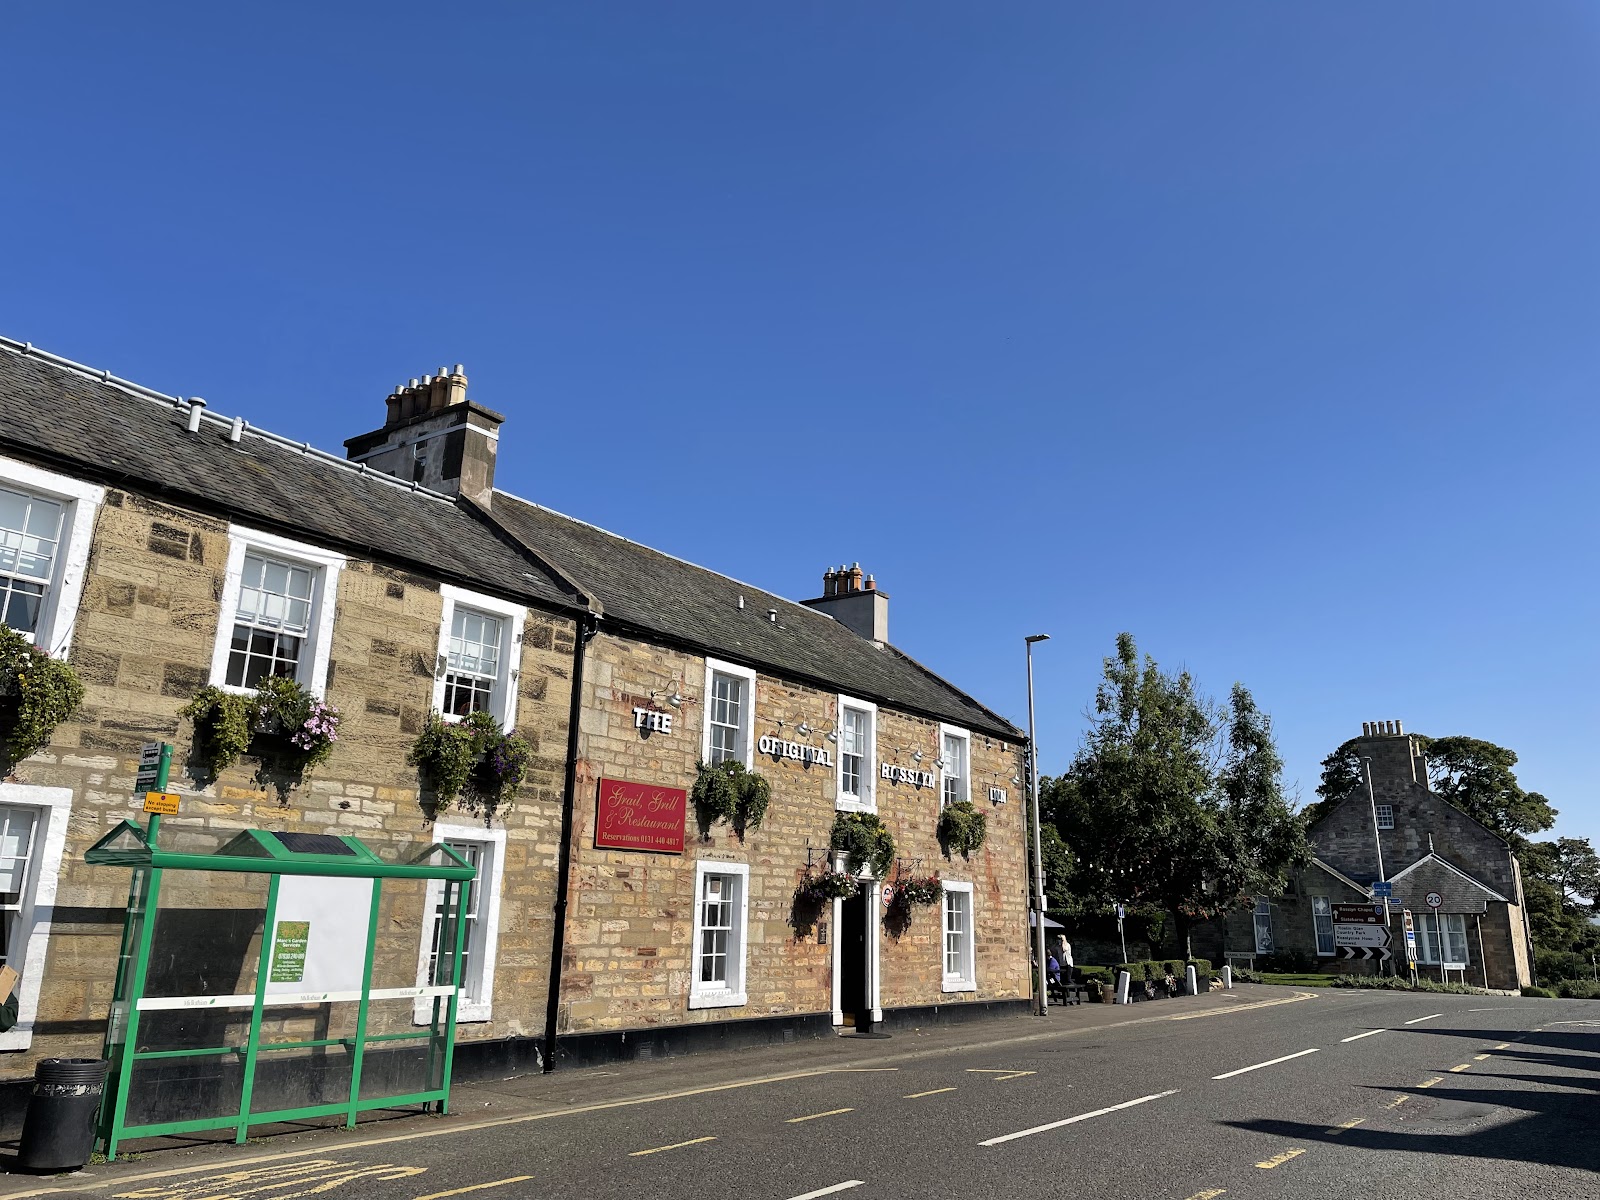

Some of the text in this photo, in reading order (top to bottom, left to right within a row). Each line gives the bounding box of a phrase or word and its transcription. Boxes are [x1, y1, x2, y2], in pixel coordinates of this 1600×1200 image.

[633, 707, 1007, 803] THE ORIGINAL ROSSLYN INN
[608, 784, 680, 812] Grail, Grill
[604, 806, 681, 831] & Restaurant
[602, 832, 680, 846] Reservations 0131 440 4817
